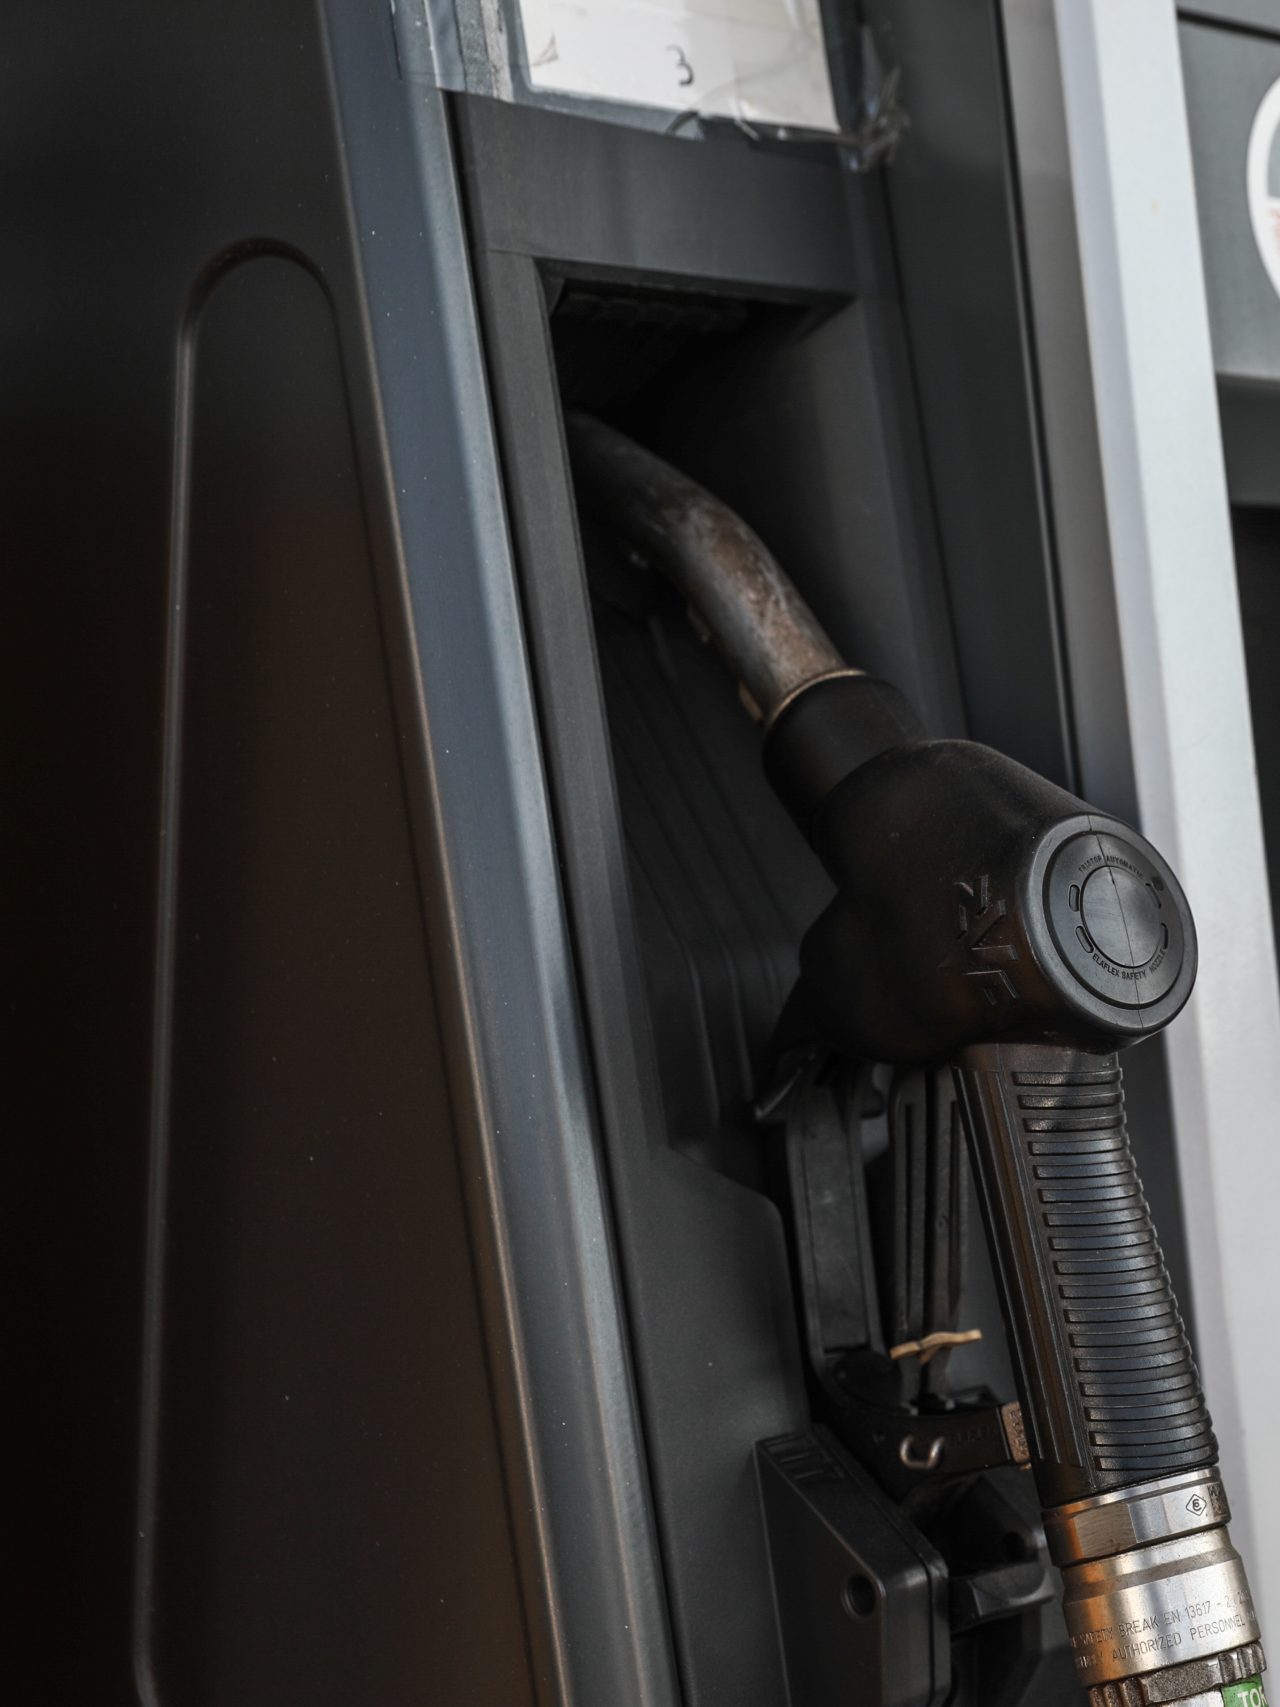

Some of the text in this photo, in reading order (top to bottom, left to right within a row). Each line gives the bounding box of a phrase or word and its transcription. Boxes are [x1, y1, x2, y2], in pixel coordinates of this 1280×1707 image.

[1092, 953, 1120, 977] ELAFLEX
[1121, 969, 1147, 981] SAFETY
[1112, 1632, 1182, 1663] AUTHORIZED
[1189, 1613, 1246, 1641] PERSONNEL
[1118, 1615, 1159, 1638] BREAK
[1163, 1609, 1180, 1626] EN
[1184, 1600, 1211, 1619] 13617
